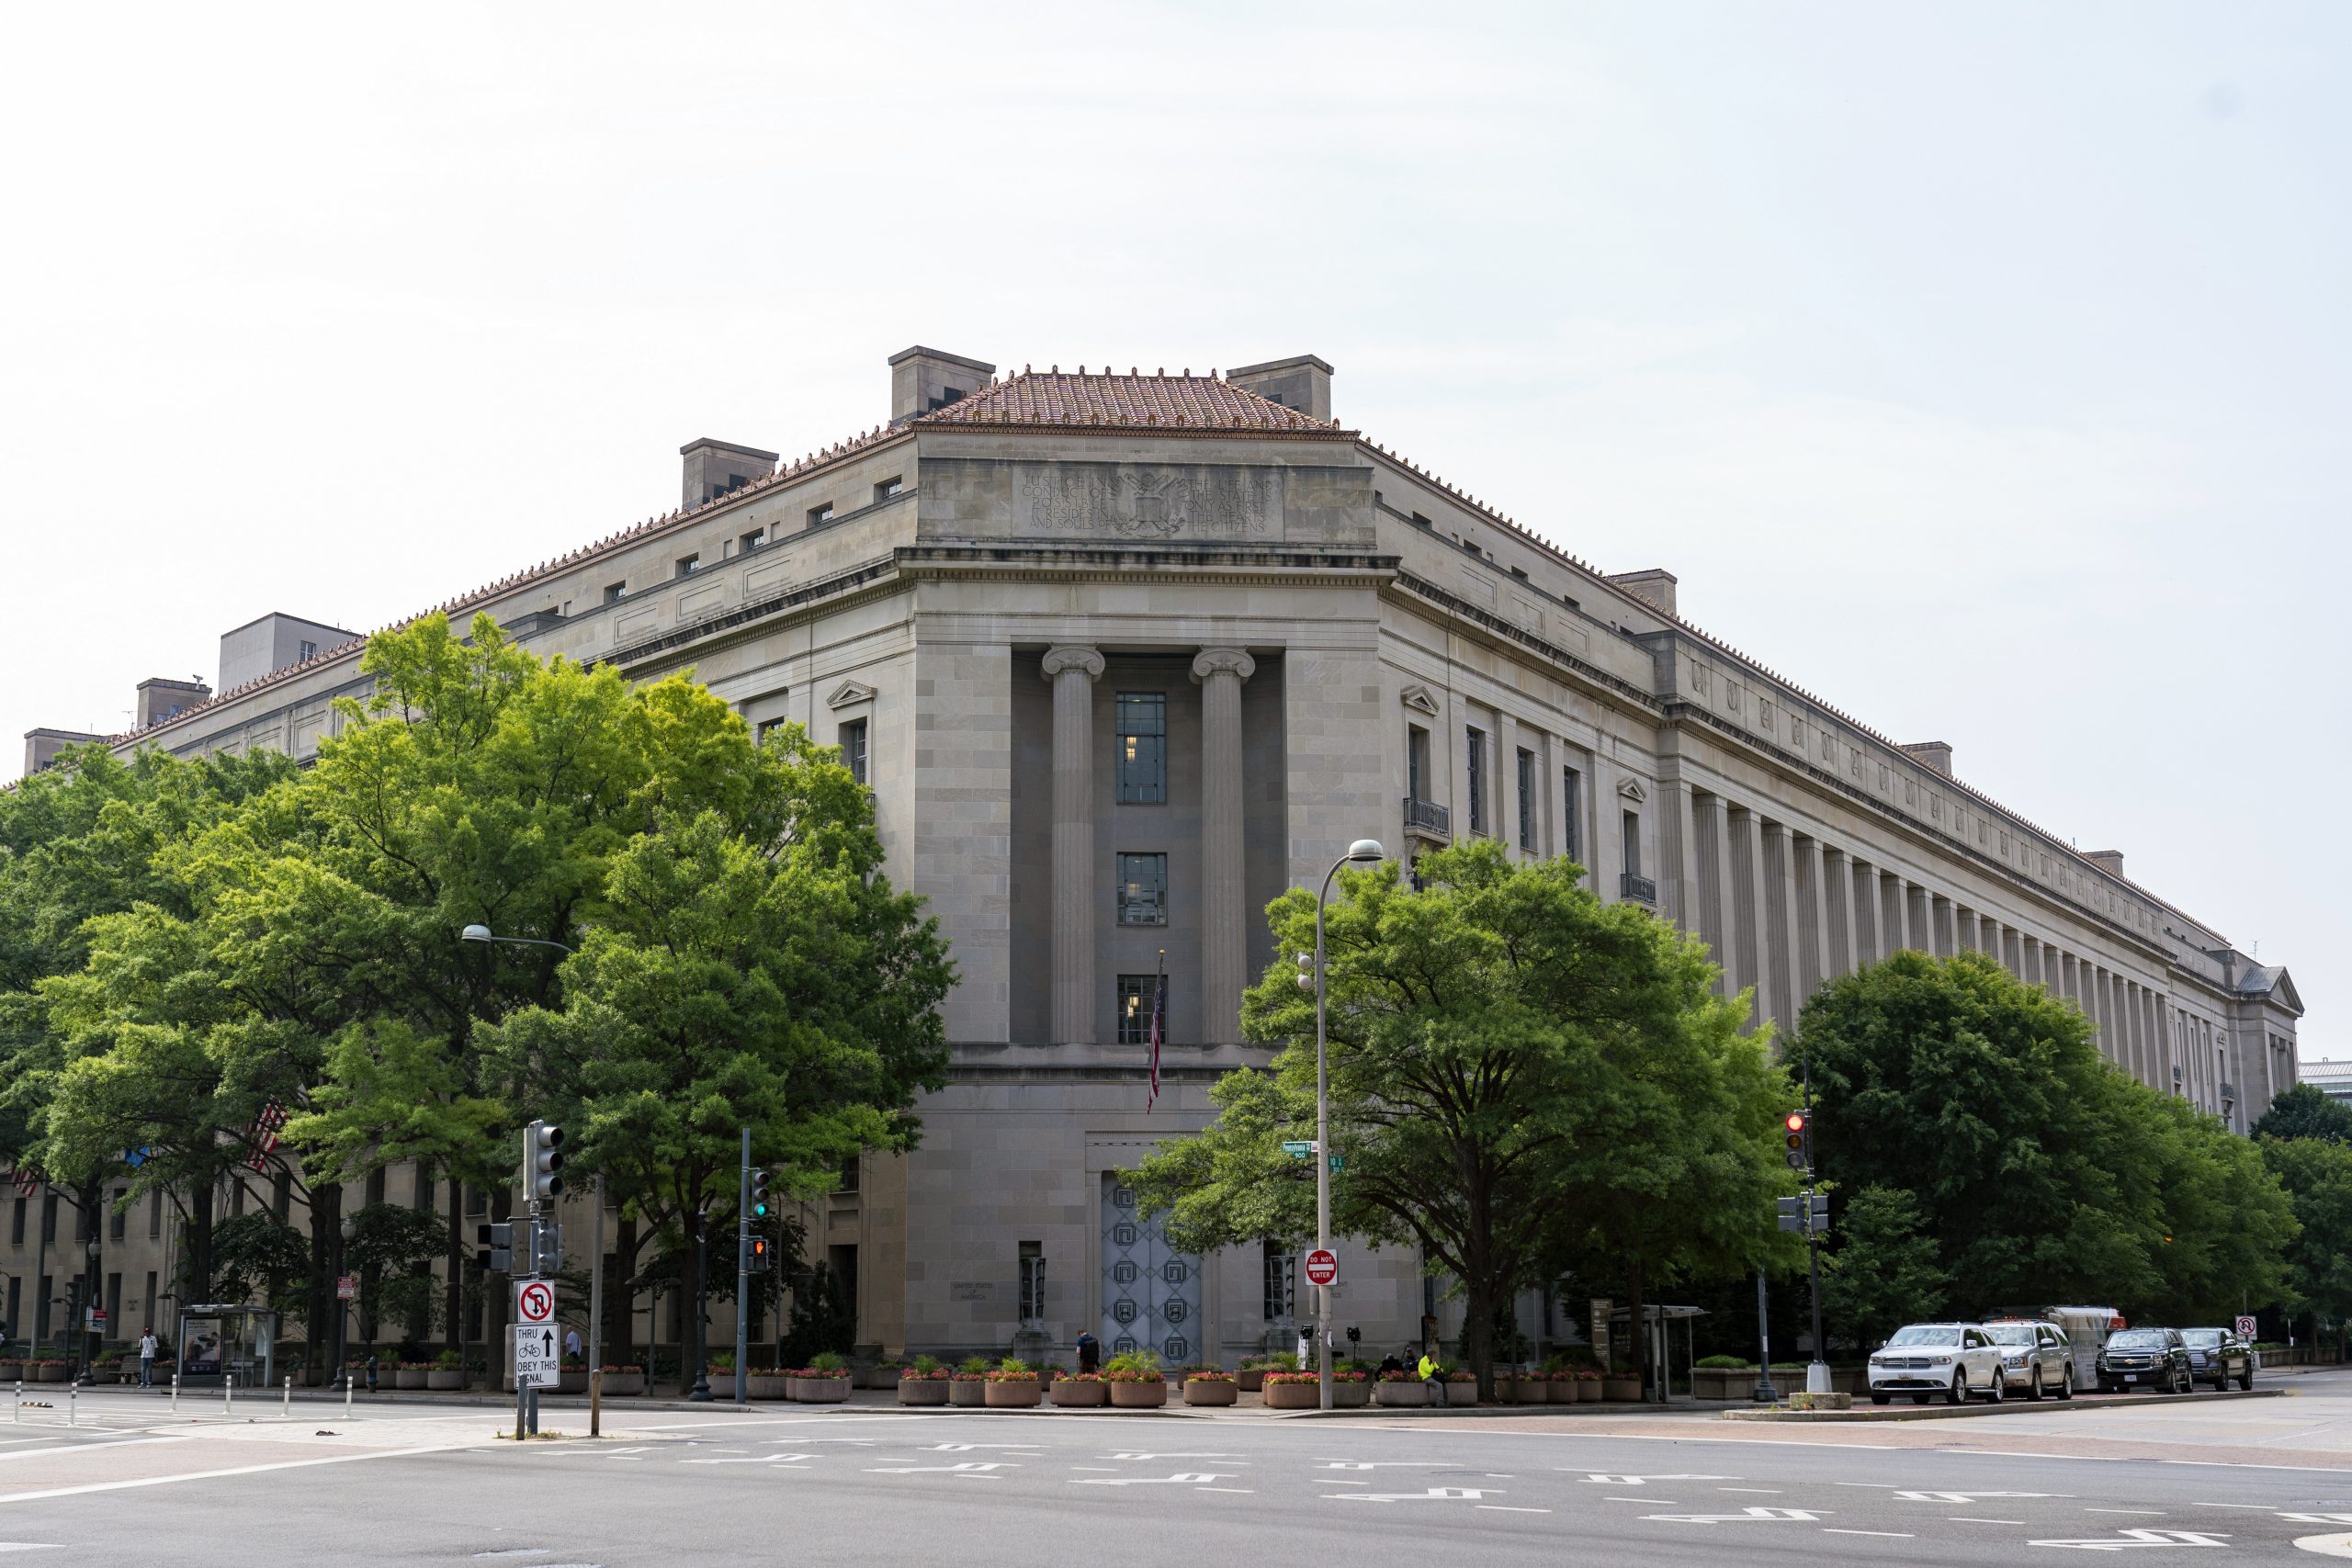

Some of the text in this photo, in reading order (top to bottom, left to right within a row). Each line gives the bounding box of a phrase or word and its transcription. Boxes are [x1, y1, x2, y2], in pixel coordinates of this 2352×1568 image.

[1022, 476, 1085, 488] JUSTICE
[1091, 477, 1106, 488] IN
[1187, 479, 1210, 490] THE
[1248, 480, 1272, 491] AND
[1022, 487, 1272, 502] CONDUCT OF THE STATE IS
[1032, 497, 1264, 513] POSSIBLE ONLY AS FIRST
[1046, 508, 1093, 519] RESIDES
[1097, 509, 1110, 519] IN
[1189, 511, 1213, 522] THE
[1219, 512, 1265, 523] HEARTS
[1029, 517, 1053, 528] AND
[1057, 519, 1094, 530] SOULS
[1187, 522, 1206, 533] THE
[1211, 522, 1265, 533] CITIZENS
[517, 1328, 537, 1339] THRU
[517, 1360, 557, 1371] OBEY THIS
[517, 1373, 544, 1384] GNAL
